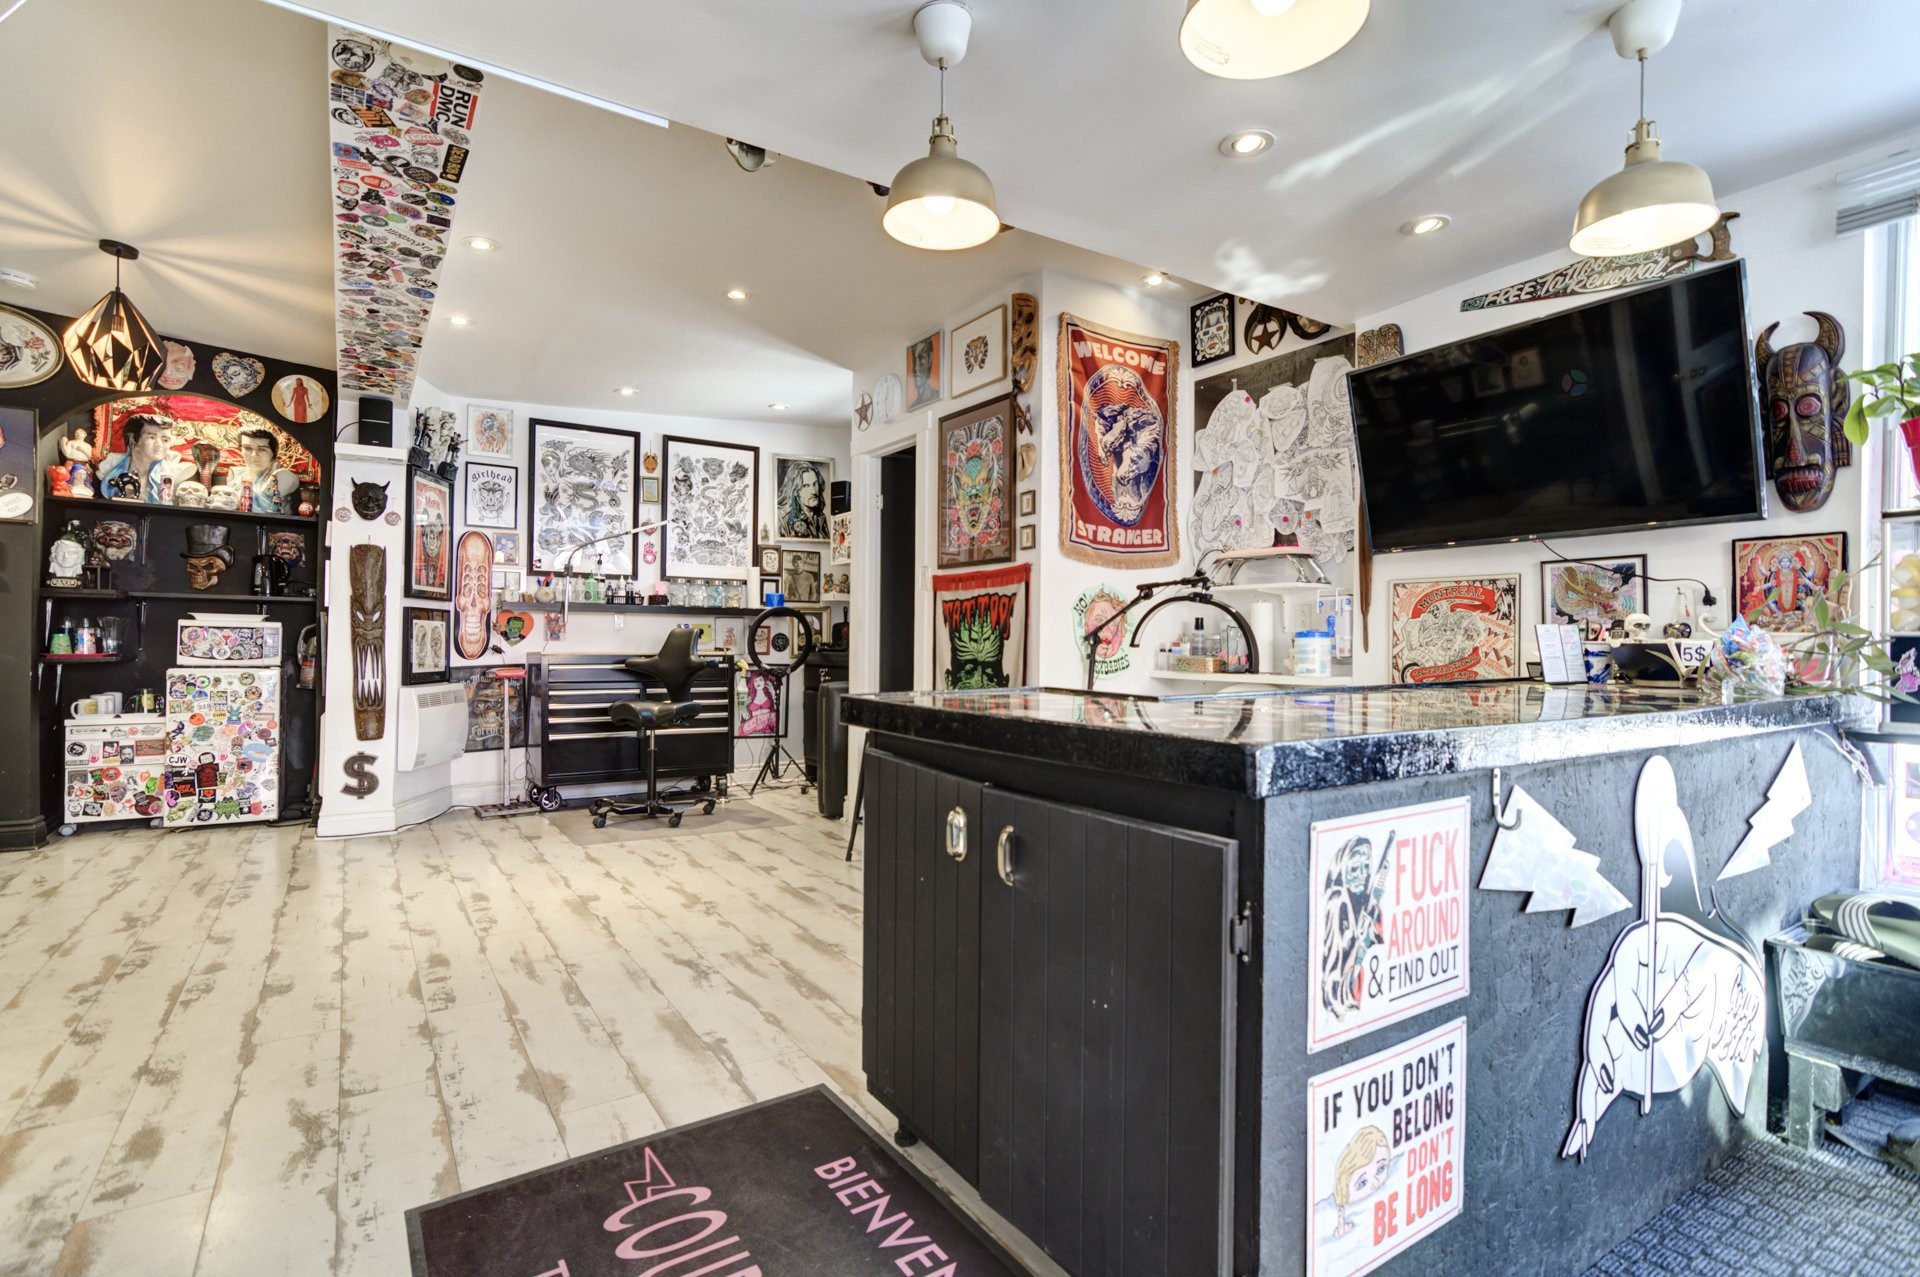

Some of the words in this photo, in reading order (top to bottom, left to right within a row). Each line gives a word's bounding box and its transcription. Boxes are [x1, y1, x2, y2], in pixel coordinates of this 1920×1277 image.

[437, 84, 455, 123] DMC
[451, 89, 472, 129] RUN
[1484, 283, 1537, 307] FREE
[1073, 341, 1166, 376] WELCOME
[472, 470, 512, 483] girlhead
[1077, 520, 1163, 546] STRANGER
[1074, 593, 1087, 616] NO!
[1419, 587, 1484, 610] MONTREAL
[1094, 654, 1130, 675] RYBABIES
[1682, 646, 1705, 664] 5$
[169, 756, 187, 764] CJW
[1395, 828, 1459, 906] FUCK
[1387, 897, 1460, 961] AROUND
[1368, 955, 1384, 999] &
[1389, 957, 1424, 993] FIND
[1430, 945, 1458, 977] OUT
[1324, 1091, 1343, 1133] IF
[1354, 1070, 1394, 1119] YOU
[1403, 1042, 1455, 1097] DON'T
[1393, 1082, 1454, 1149] BELONG
[1407, 1126, 1454, 1178] DON'T
[1373, 1191, 1399, 1247] BE
[1406, 1160, 1453, 1227] LONG
